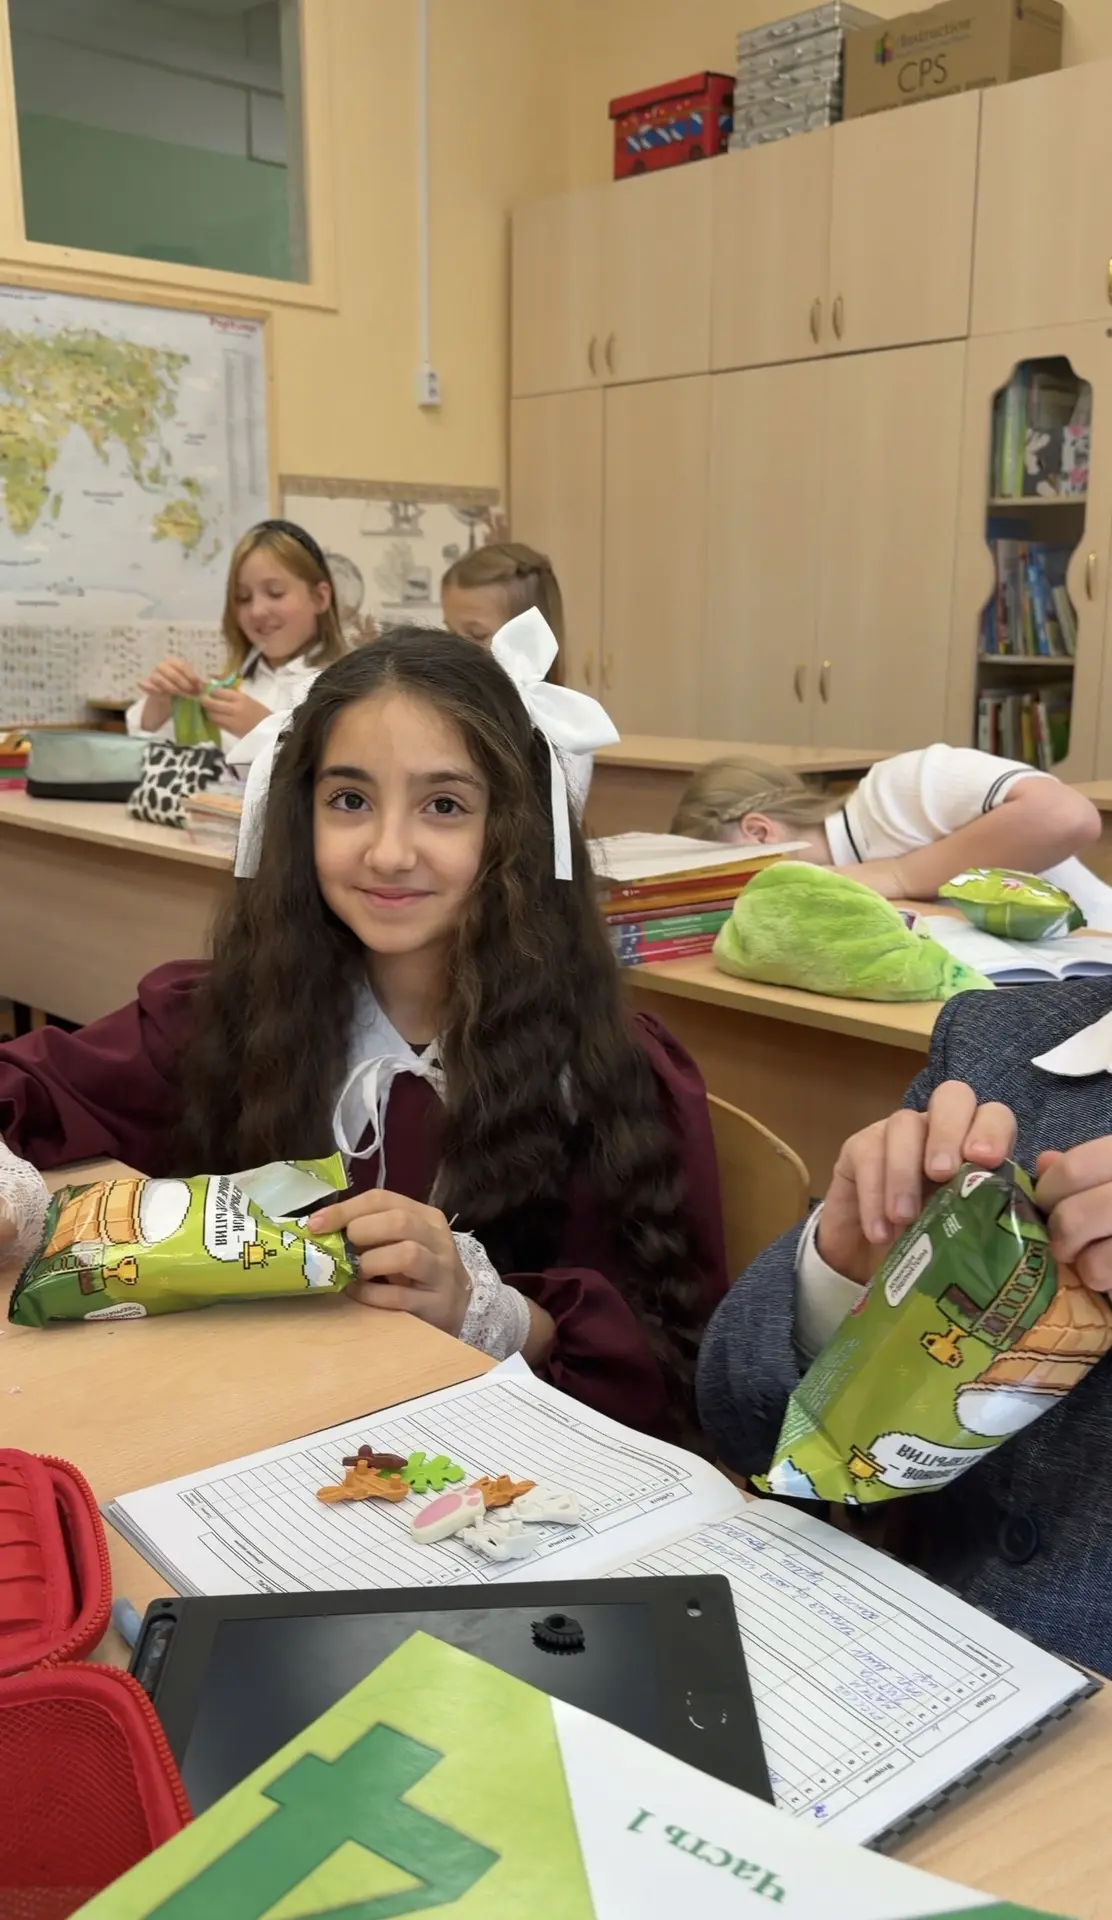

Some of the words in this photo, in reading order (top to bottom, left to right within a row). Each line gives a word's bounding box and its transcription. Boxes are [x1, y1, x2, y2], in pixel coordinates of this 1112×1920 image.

[898, 53, 947, 93] CPS
[626, 1806, 657, 1835] 1
[664, 1823, 787, 1904] Часть
